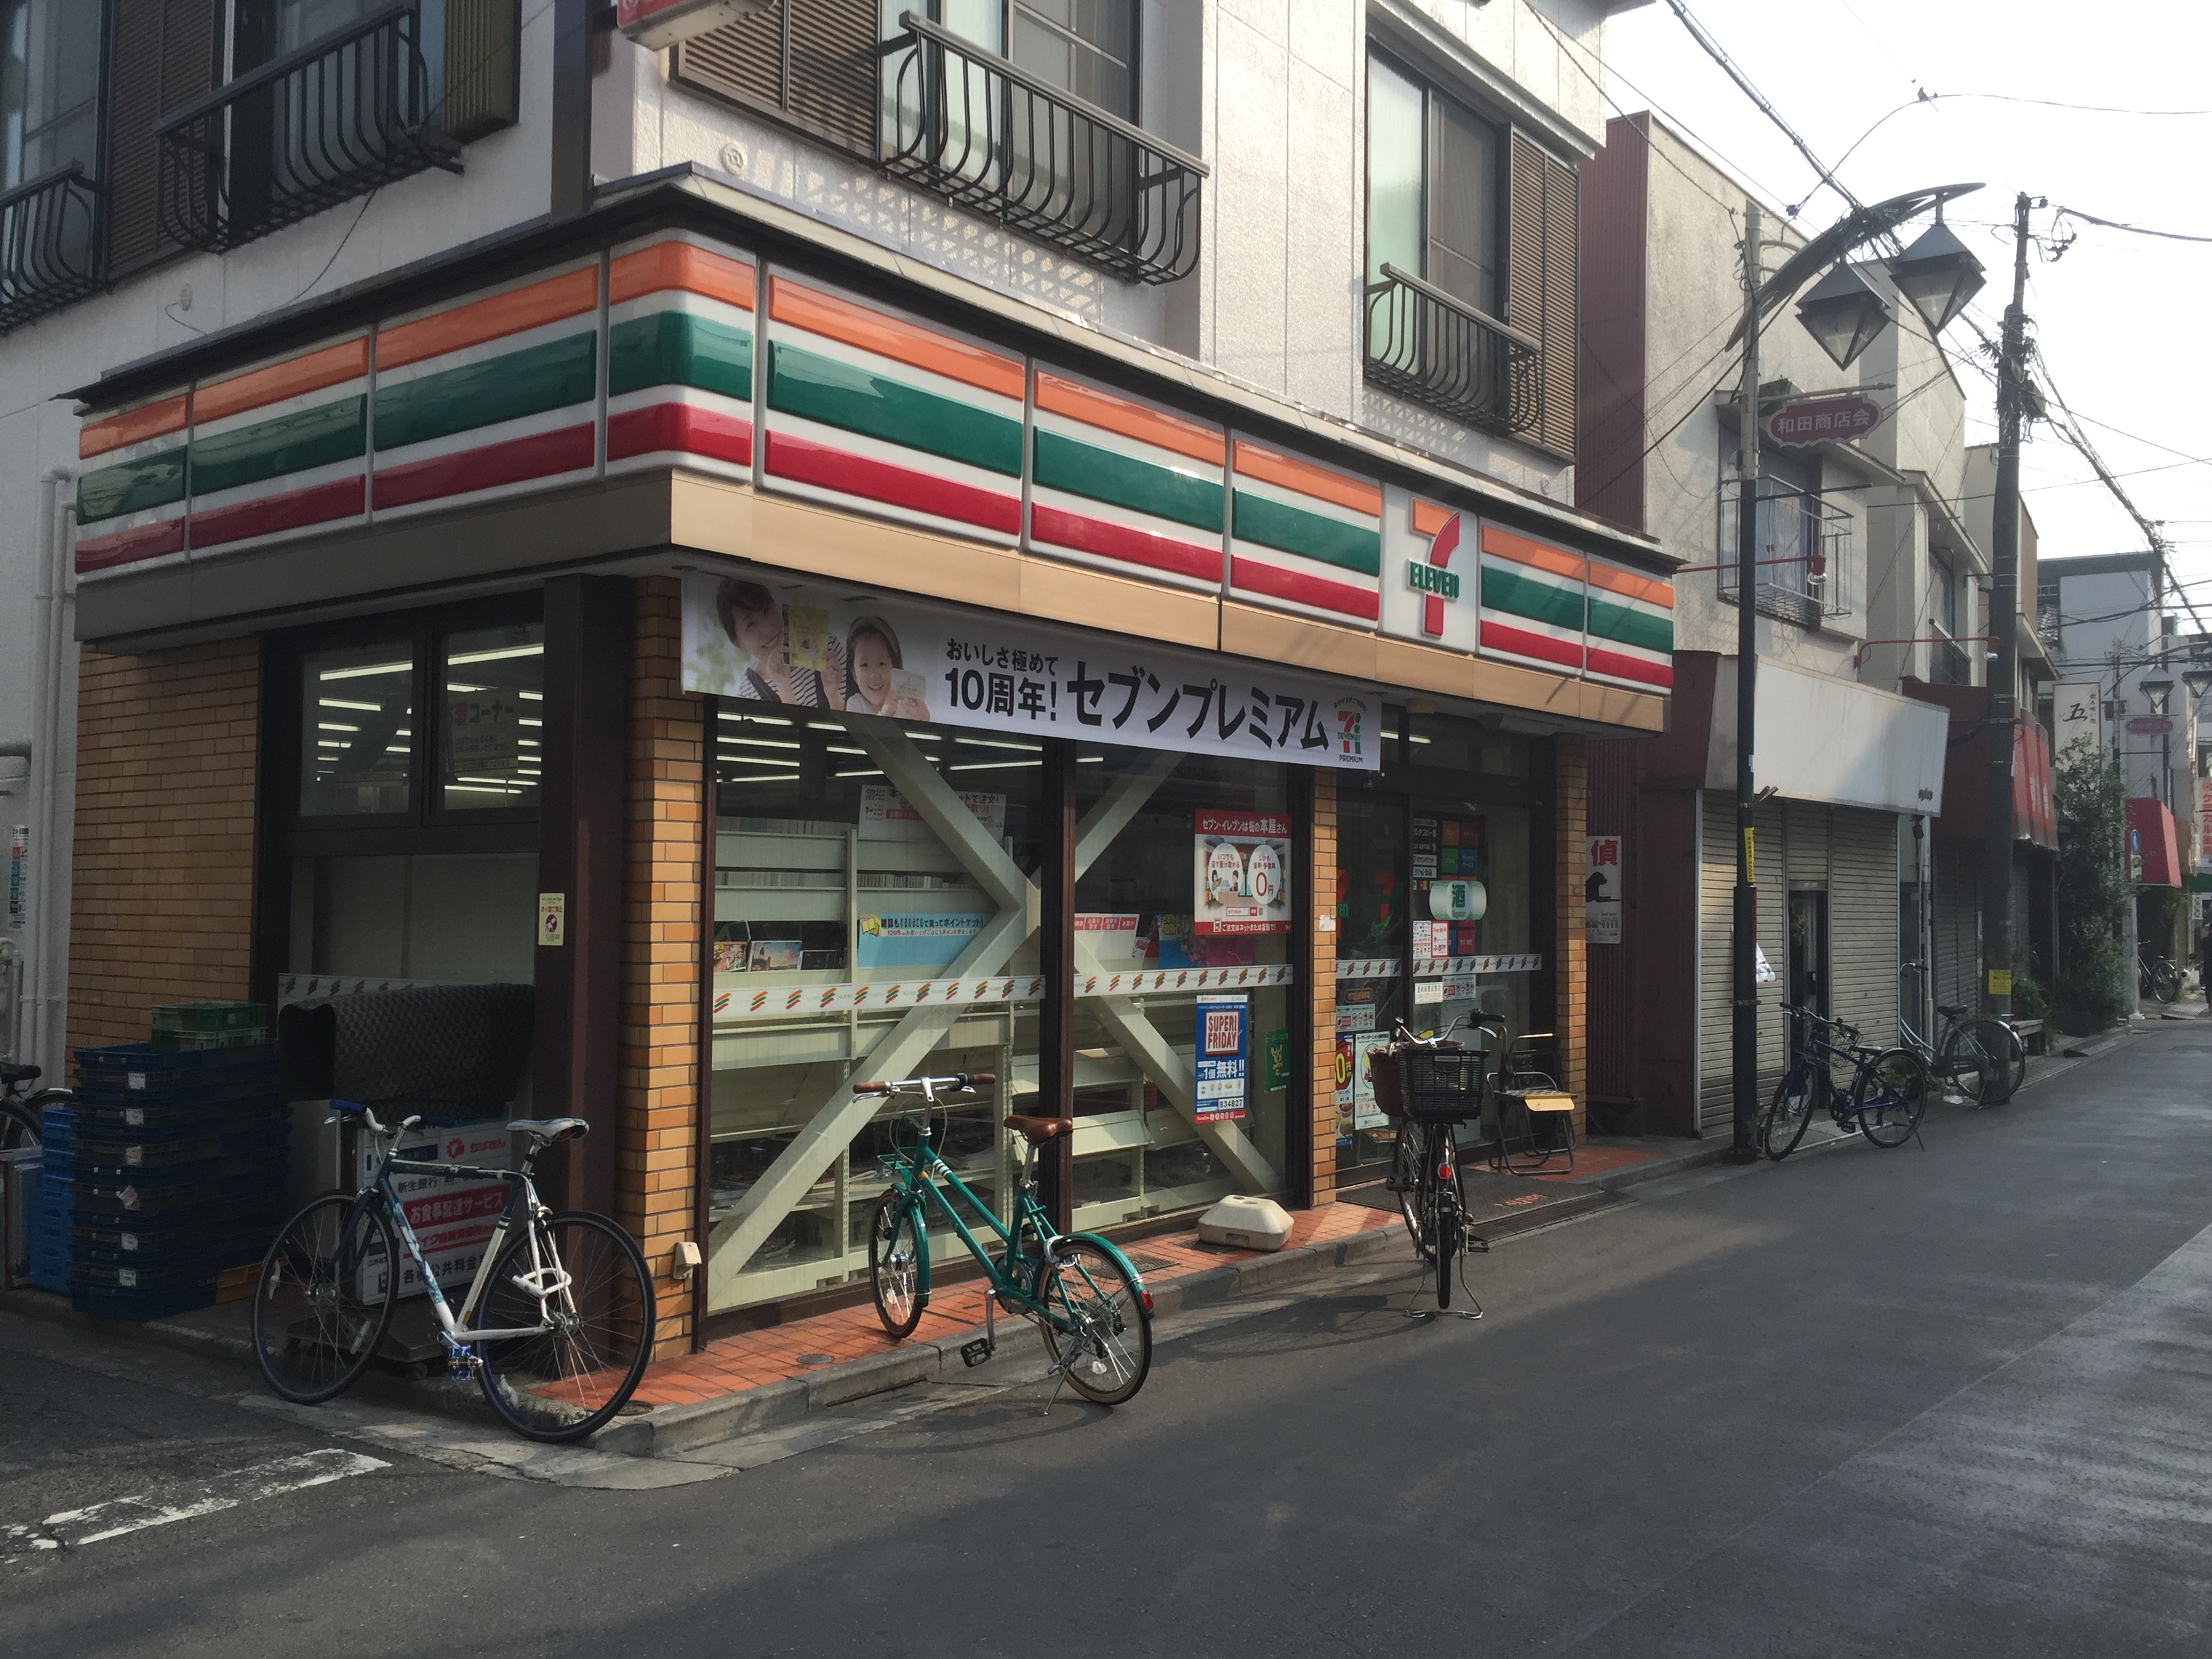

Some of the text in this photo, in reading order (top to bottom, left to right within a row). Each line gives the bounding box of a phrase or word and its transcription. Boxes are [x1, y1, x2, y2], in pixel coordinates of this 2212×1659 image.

[1777, 409, 1870, 435] 和田商店会
[946, 638, 1059, 676] おいしさ極めて
[1067, 660, 1329, 752] セブンプレミアム
[1339, 754, 1364, 764] PREMIUM
[1208, 1031, 1237, 1049] FRIDAY
[1219, 1099, 1243, 1109] 834827
[470, 1139, 506, 1153] ちばぎん
[398, 1176, 438, 1193] 新生銀行
[410, 1191, 504, 1225] お食事配達サービス
